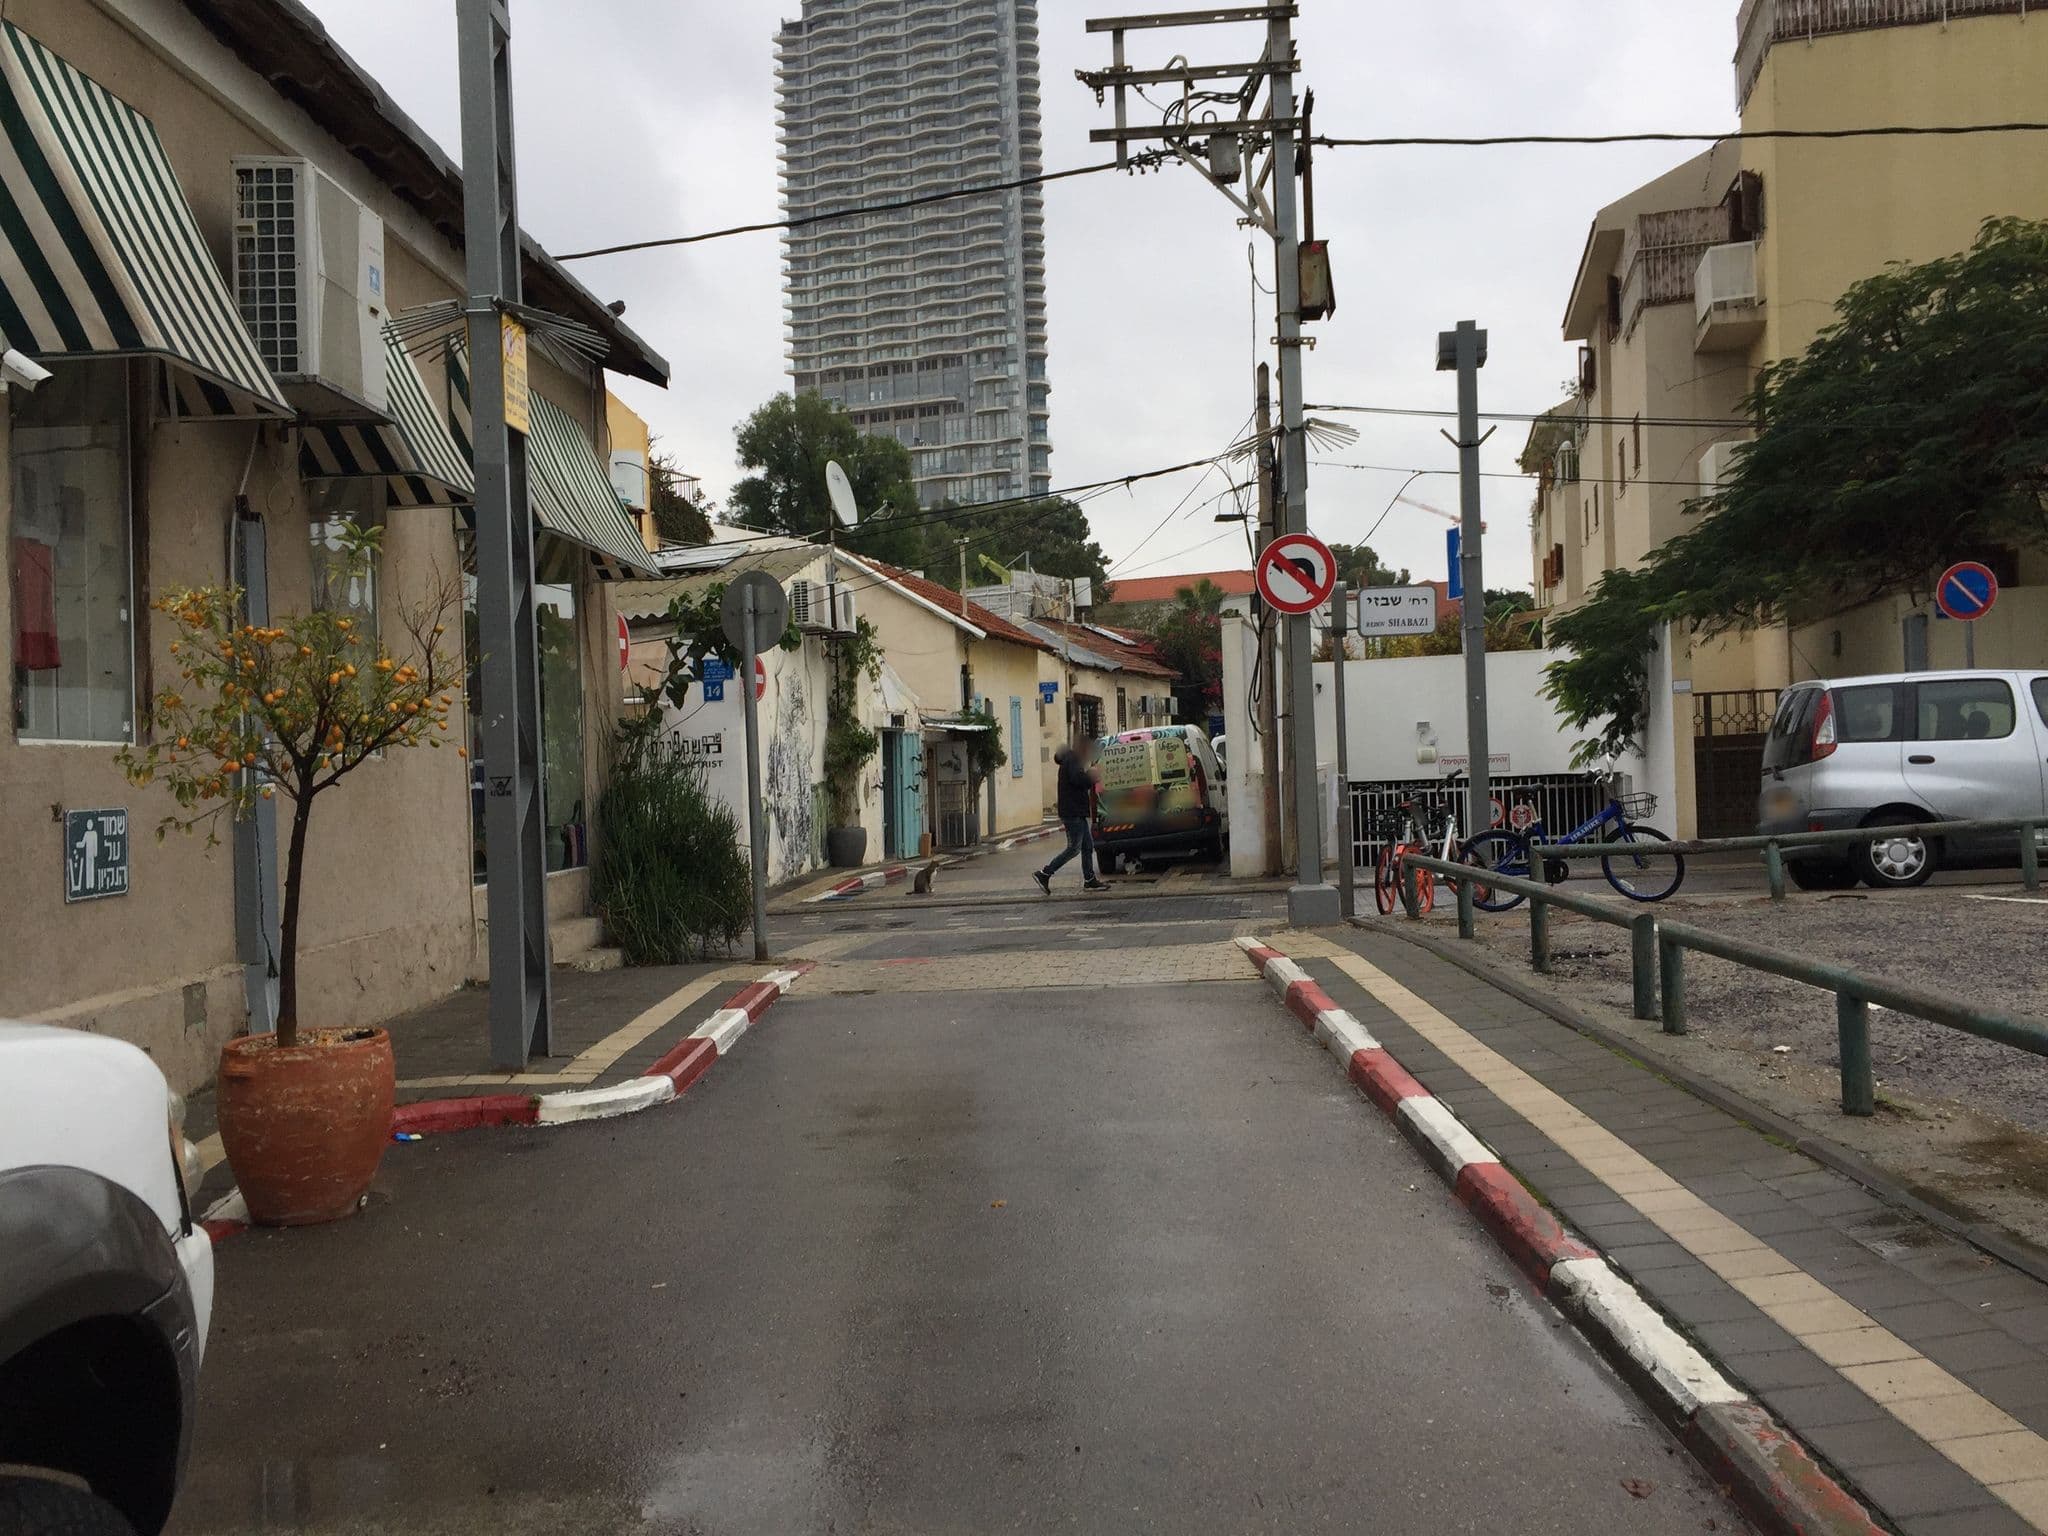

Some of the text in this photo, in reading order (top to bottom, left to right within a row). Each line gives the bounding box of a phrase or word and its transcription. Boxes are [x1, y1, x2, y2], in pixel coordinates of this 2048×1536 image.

[1366, 596, 1402, 606] שבזי
[1388, 618, 1428, 627] SHABAZI
[98, 815, 126, 837] שמור
[104, 839, 121, 862] על
[97, 865, 128, 891] הנקיון
